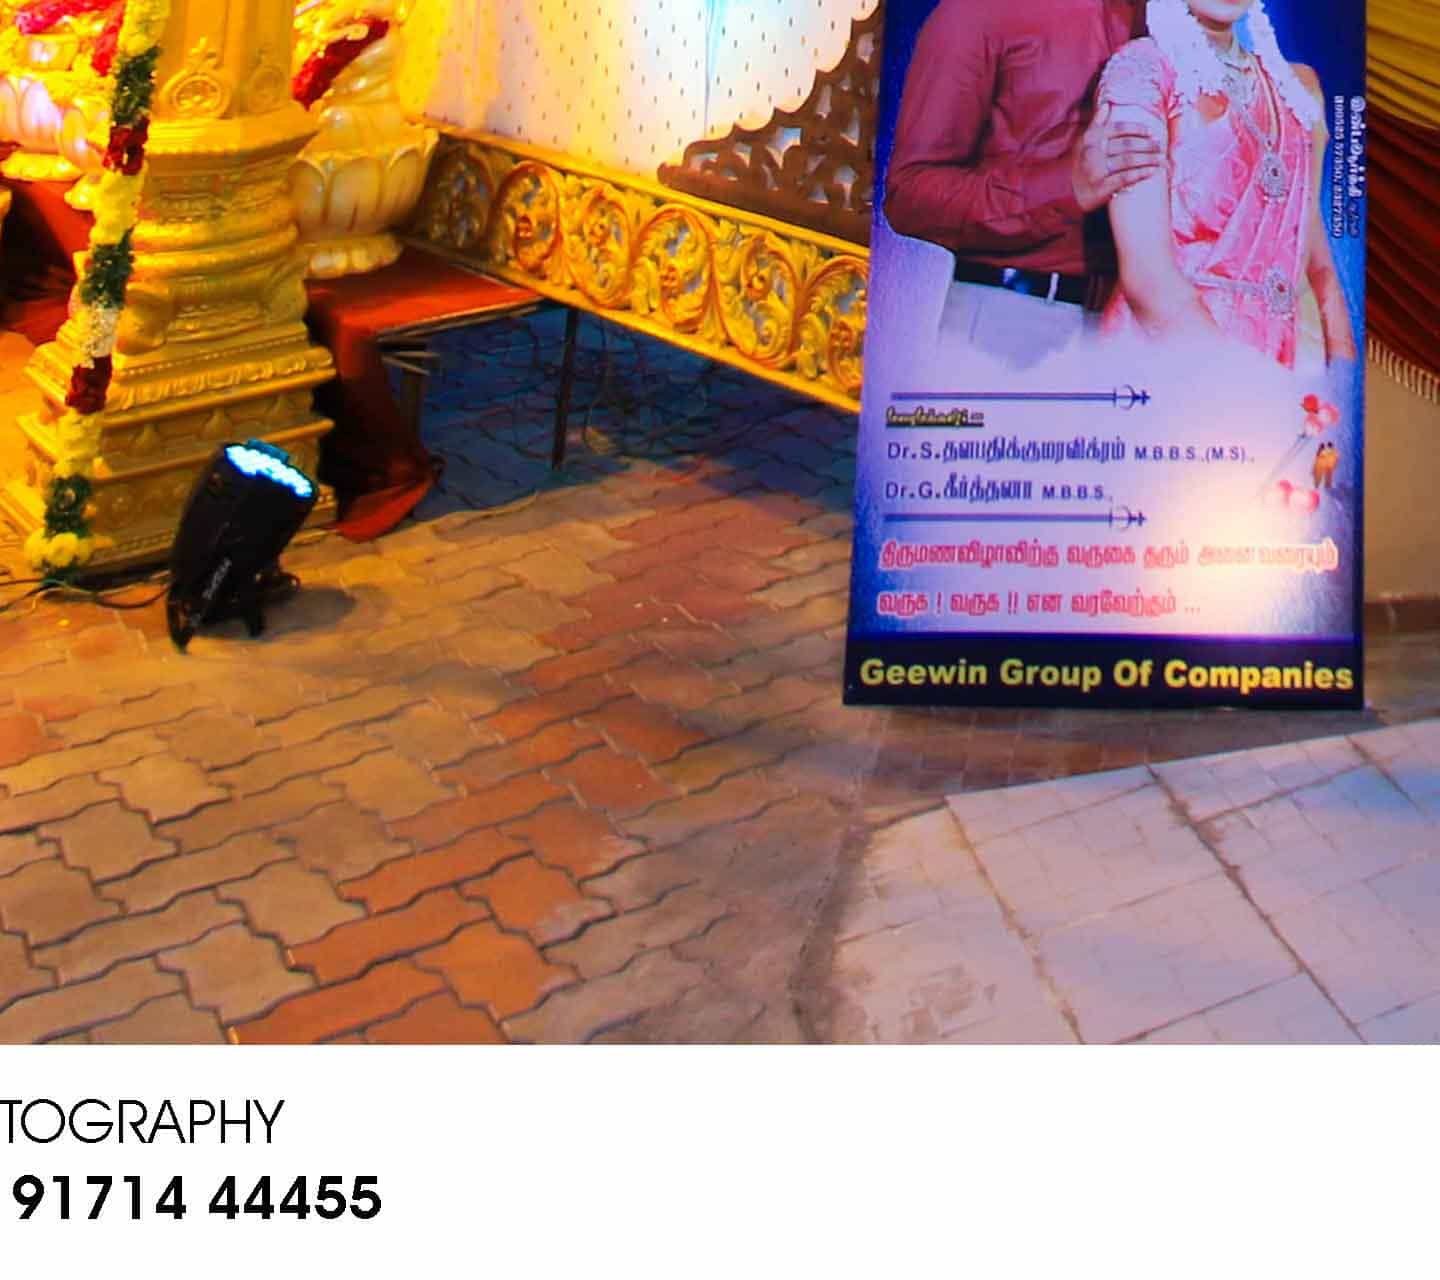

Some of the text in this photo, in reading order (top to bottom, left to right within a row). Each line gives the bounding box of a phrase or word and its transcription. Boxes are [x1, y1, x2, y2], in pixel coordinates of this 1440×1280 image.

[1067, 544, 1136, 568] வருகை
[877, 591, 929, 618] வருக
[950, 591, 1001, 618] வருக
[1027, 592, 1063, 614] என
[860, 658, 1354, 694] Geewin Group Of Companies
